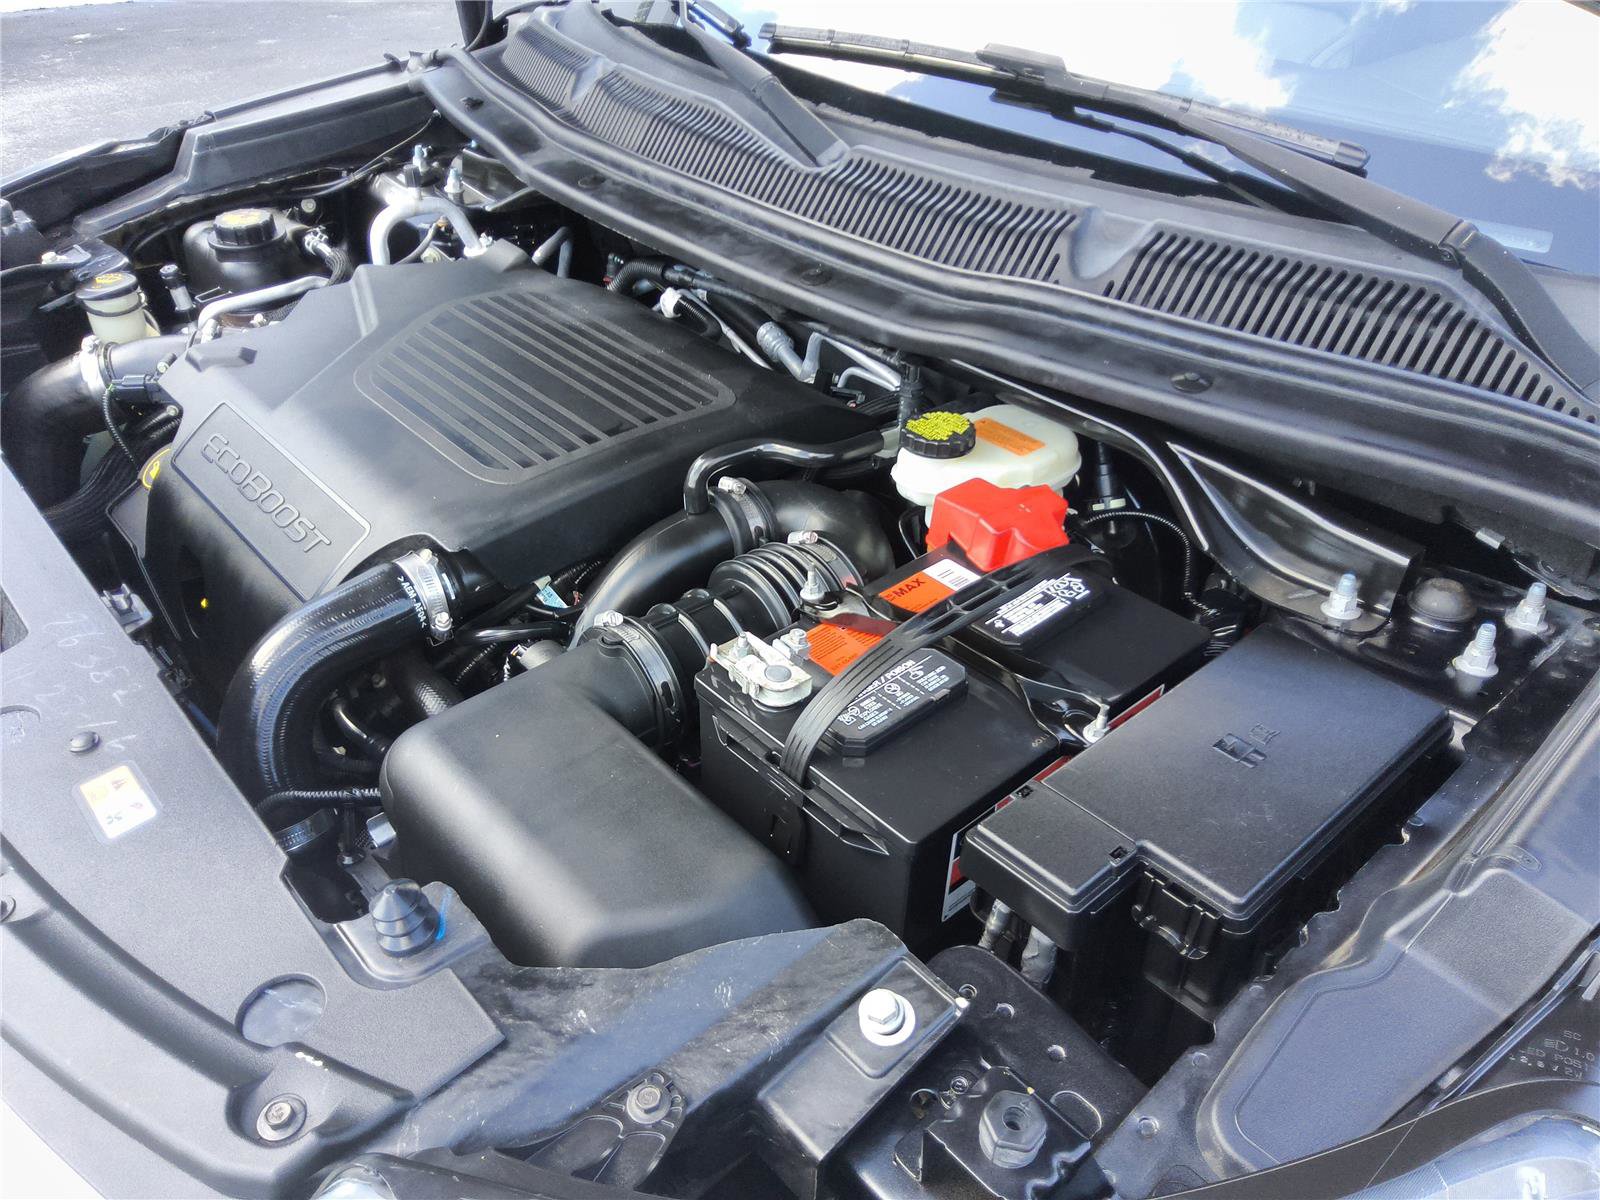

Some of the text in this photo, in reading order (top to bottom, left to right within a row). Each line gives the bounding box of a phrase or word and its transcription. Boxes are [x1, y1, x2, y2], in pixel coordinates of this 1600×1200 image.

[201, 433, 332, 554] ECOBOOST
[891, 578, 926, 598] MAX
[885, 660, 915, 680] POISON
